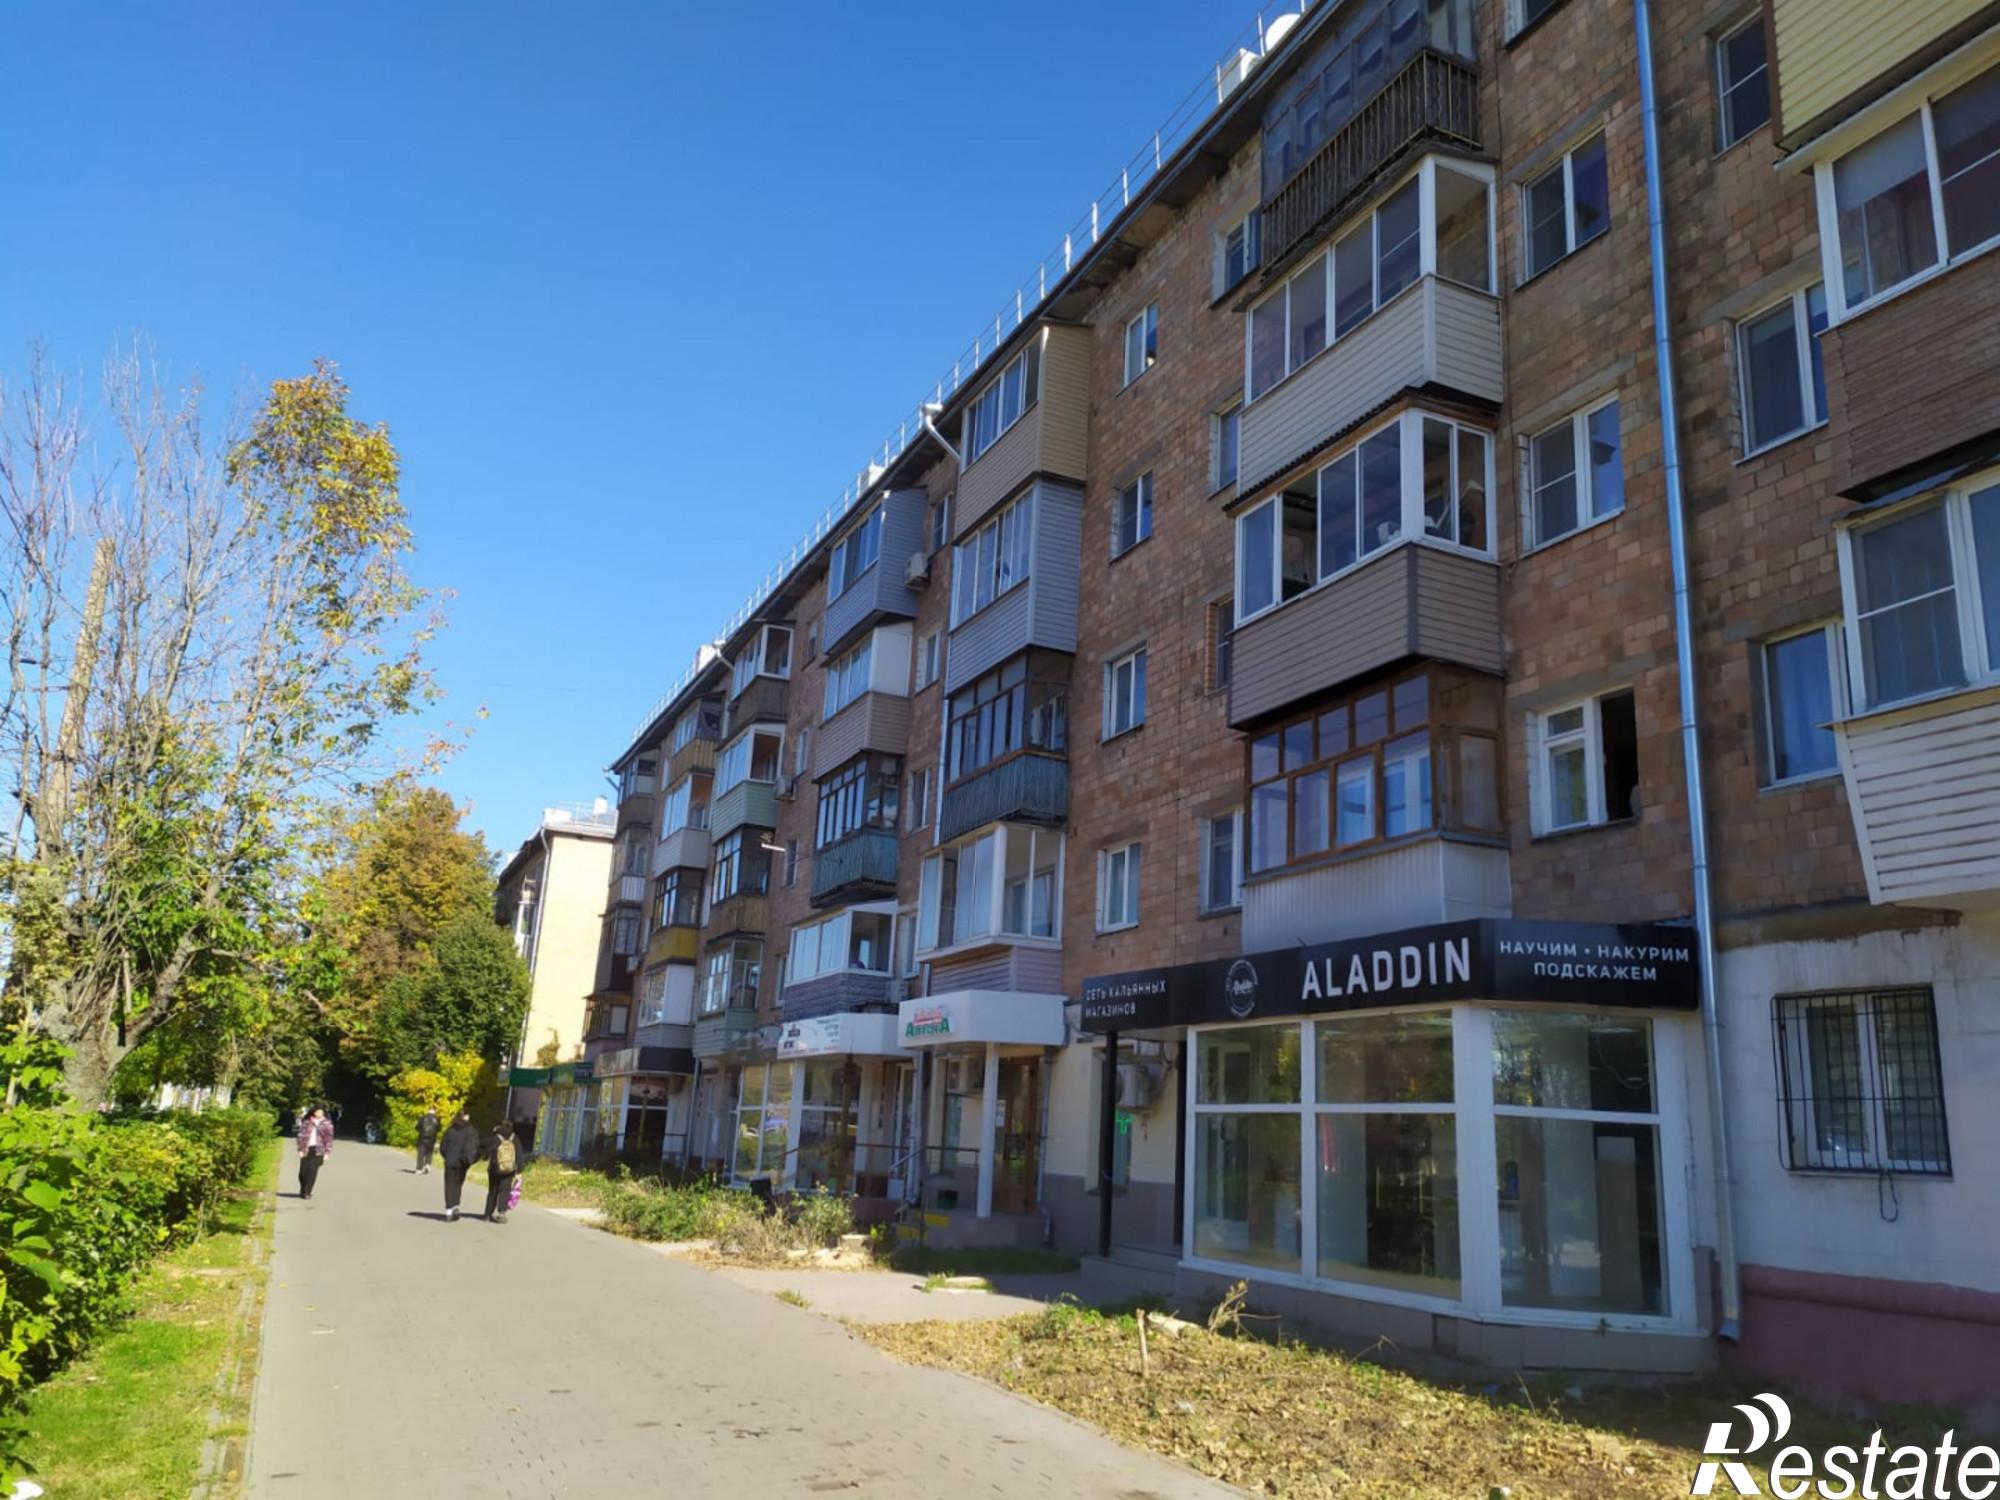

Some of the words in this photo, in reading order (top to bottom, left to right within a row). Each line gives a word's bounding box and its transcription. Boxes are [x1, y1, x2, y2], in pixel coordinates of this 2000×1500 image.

[1499, 940, 1577, 957] НАУЧИМ
[1597, 945, 1690, 963] НАКУРИМ
[1301, 937, 1471, 1000] ALADDIN
[1533, 961, 1657, 981] ПОДСКАЖЕМ
[1085, 987, 1107, 1001] СЕТЬ
[1108, 979, 1167, 1000] КАЛЬЯННЫХ
[1085, 1002, 1137, 1018] МАГАЗИНОВ
